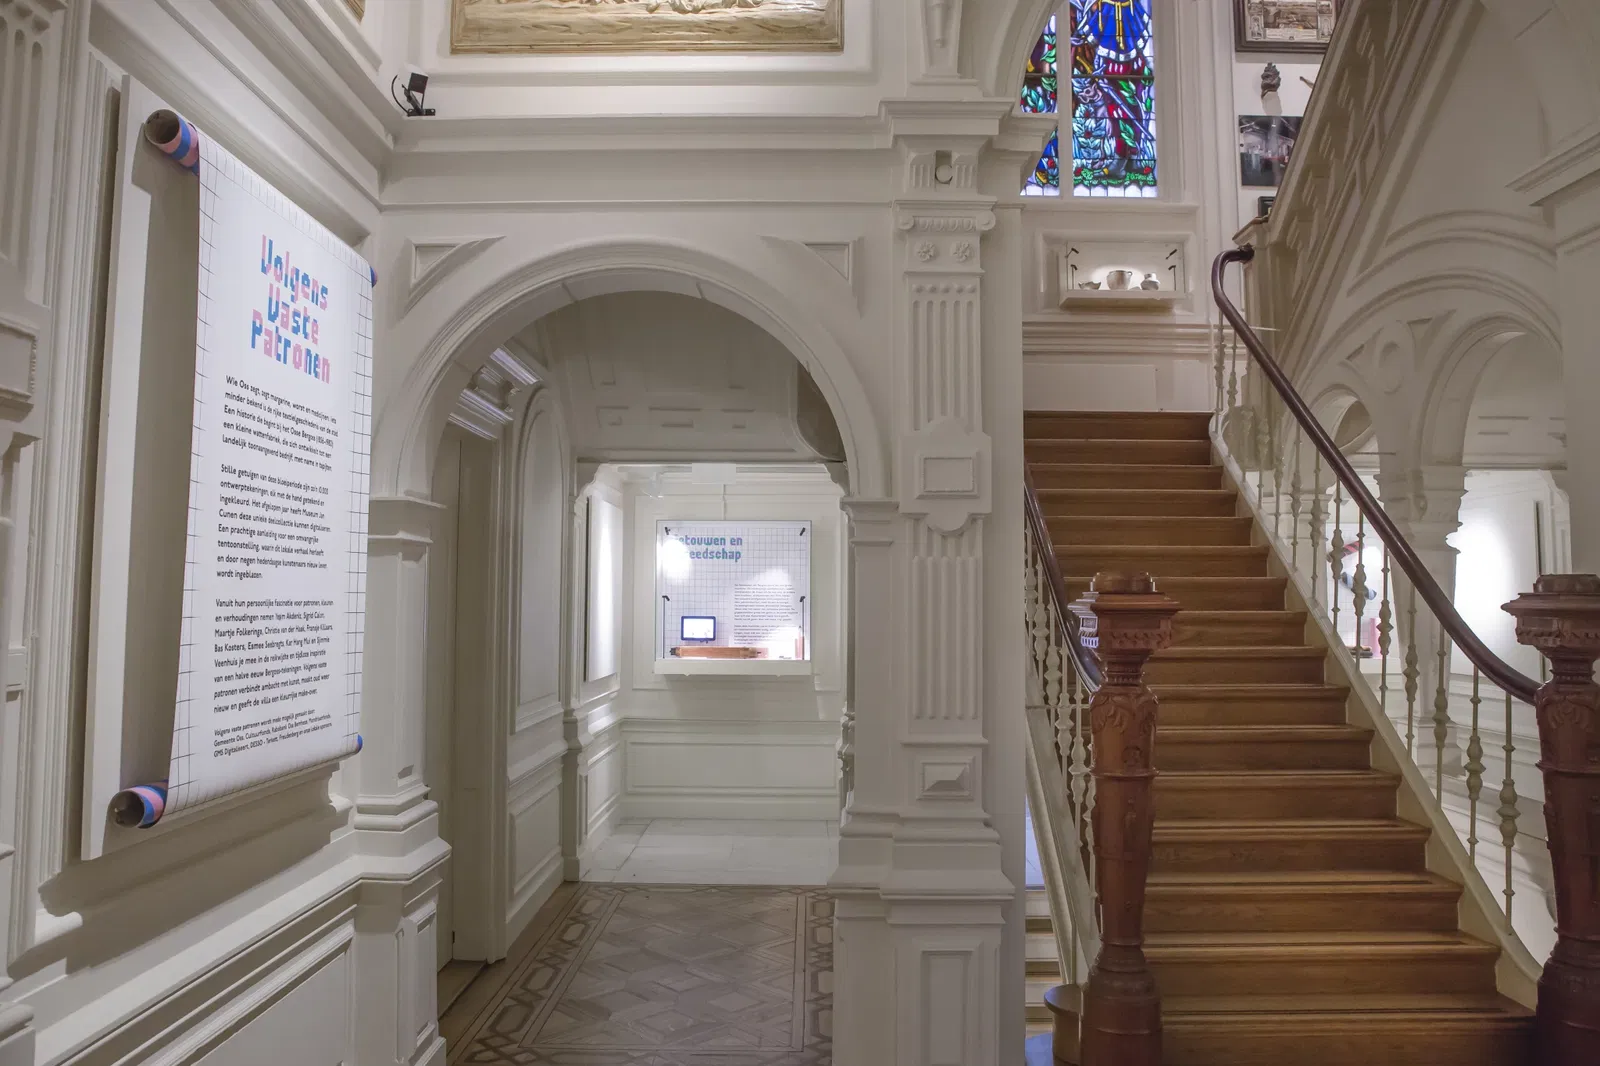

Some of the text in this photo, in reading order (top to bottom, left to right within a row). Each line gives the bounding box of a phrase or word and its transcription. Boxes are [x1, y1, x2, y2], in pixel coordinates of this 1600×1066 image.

[261, 234, 328, 311] Volgens
[268, 283, 319, 345] Vaste
[251, 309, 330, 384] Patronen
[225, 392, 245, 403] minder
[224, 404, 235, 414] Een
[237, 409, 255, 421] historie
[236, 423, 251, 434] kleine
[221, 464, 236, 474] Stille
[238, 470, 259, 480] getuigen
[219, 508, 237, 519] Cunen
[239, 512, 251, 520] deze
[218, 524, 229, 532] Een
[231, 527, 256, 538] prachtige
[676, 535, 742, 546] etouwen en
[226, 554, 239, 563] door
[240, 557, 256, 566] negen
[688, 548, 742, 562] eedschap
[216, 599, 233, 607] Vanuit
[224, 614, 259, 624] verhoudingen
[215, 629, 235, 639] Maartje
[215, 644, 223, 652] Bas
[215, 659, 237, 667] Veenhuis
[239, 659, 244, 668] je
[214, 689, 237, 700] patronen
[238, 699, 252, 711] geeft
